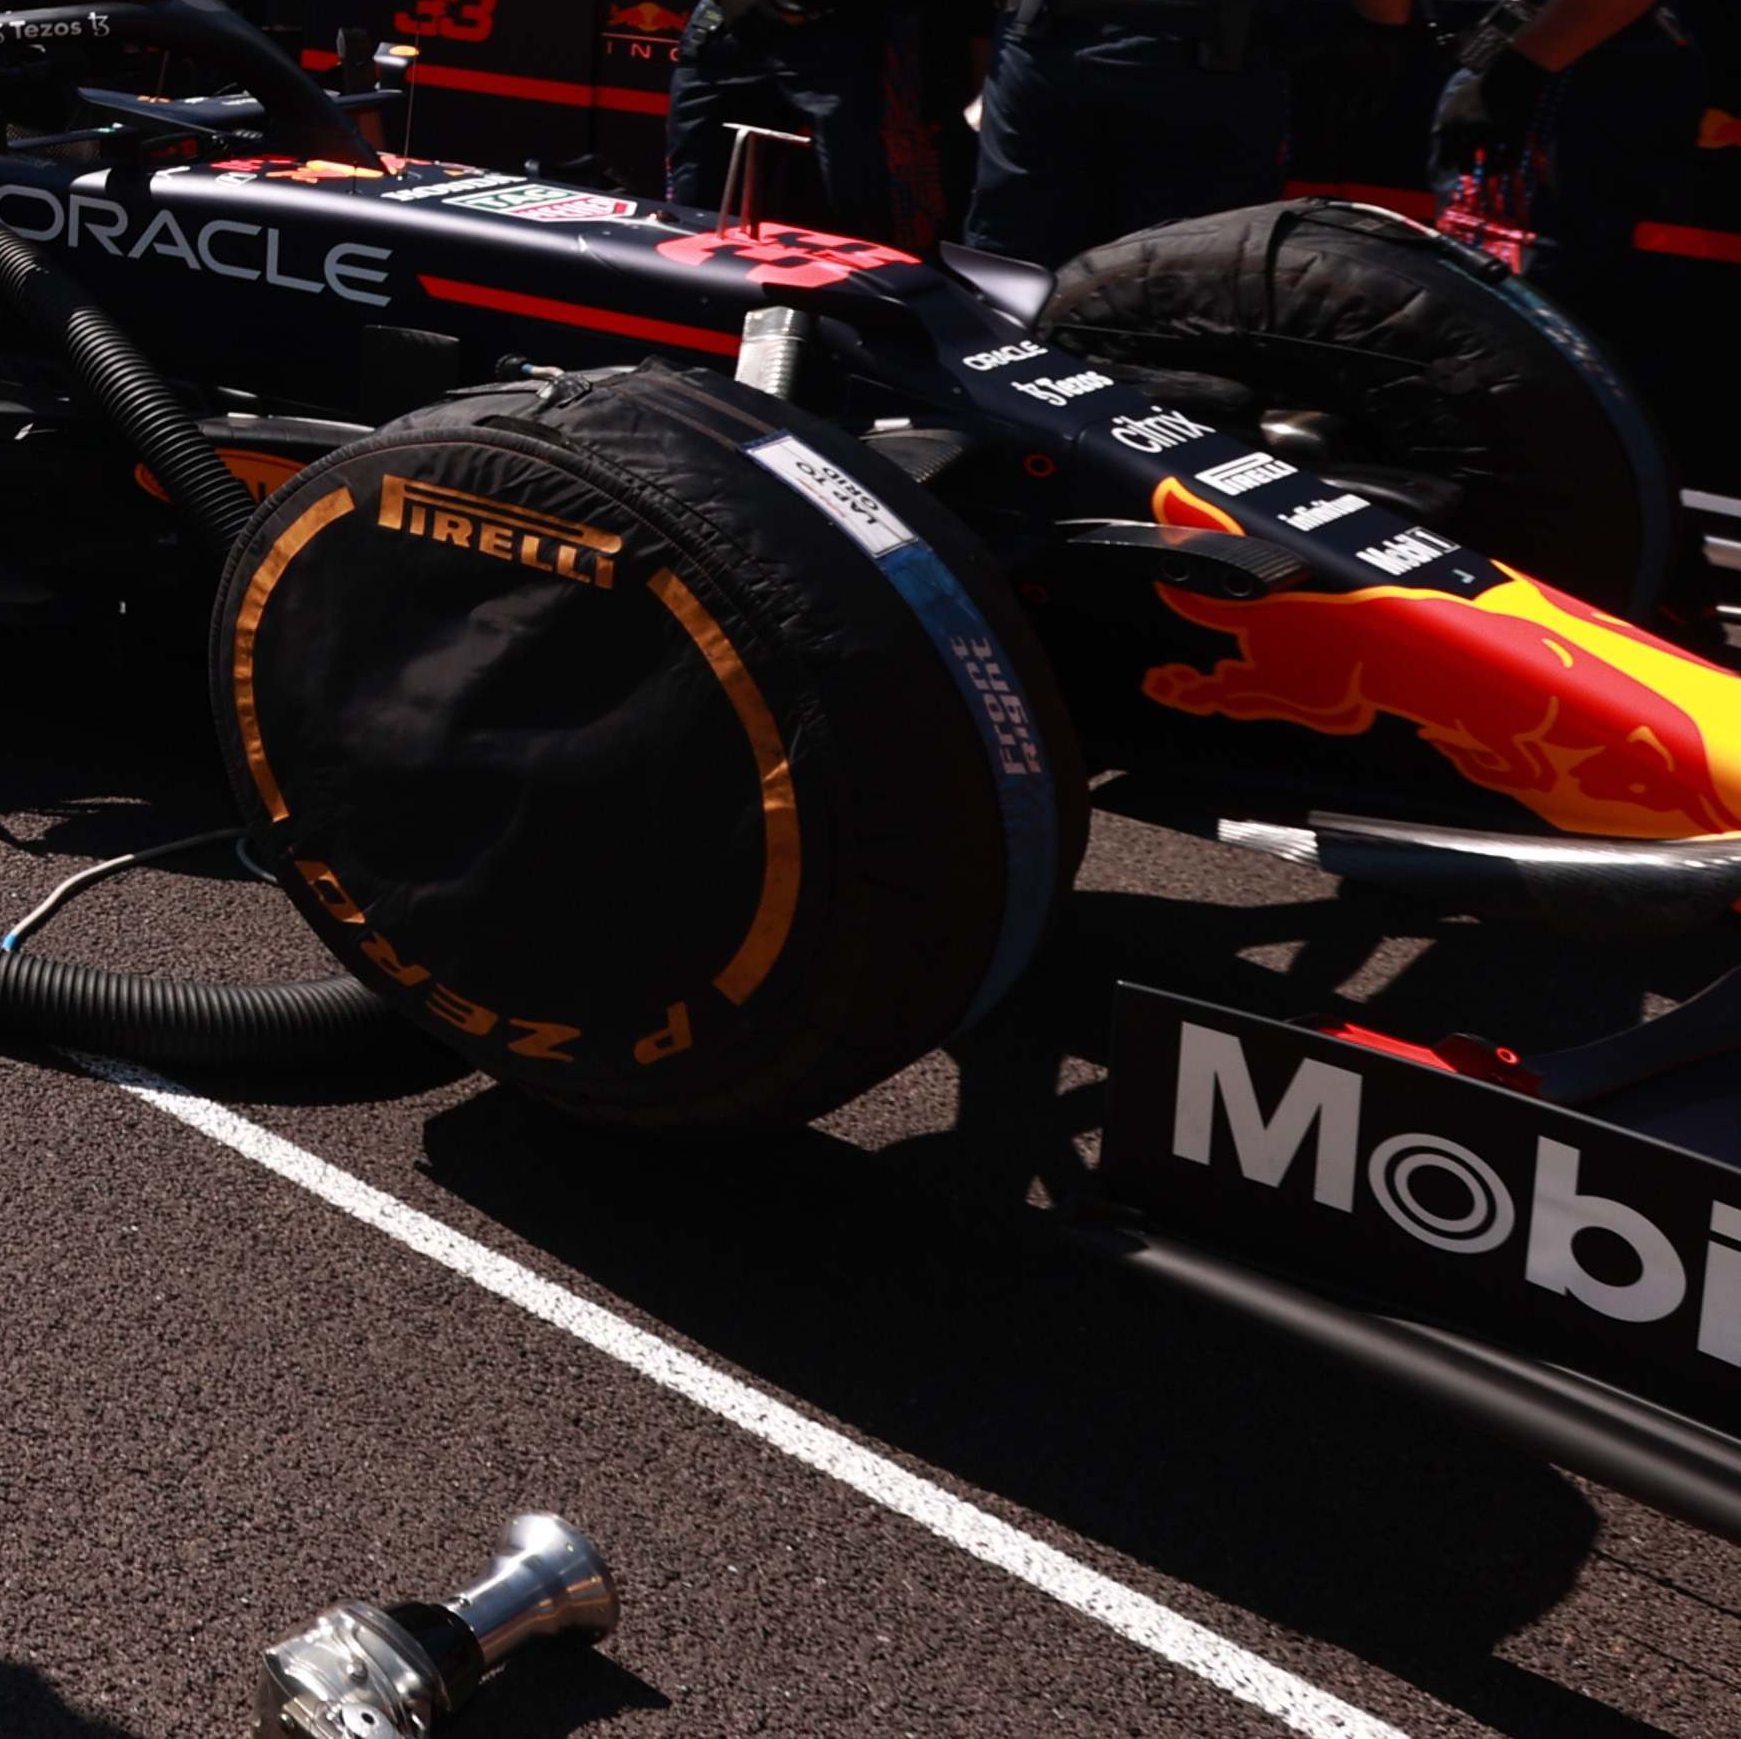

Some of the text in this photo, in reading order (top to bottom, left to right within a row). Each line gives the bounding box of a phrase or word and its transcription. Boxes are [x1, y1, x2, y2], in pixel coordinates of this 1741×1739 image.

[9, 21, 82, 40] Tezos
[381, 176, 528, 202] HONDA
[471, 188, 568, 210] TAG
[963, 340, 1049, 371] ORACLE
[1035, 370, 1115, 399] Tezos
[1110, 405, 1217, 454] citrix
[796, 461, 828, 487] TO
[823, 467, 880, 512] GRID
[1194, 452, 1299, 496] PIRELLI
[832, 490, 878, 526] LAP
[1277, 494, 1371, 531] infinitum
[378, 474, 623, 589] PIRELLI
[1355, 531, 1443, 576] Mobil
[950, 636, 1029, 775] Front
[970, 637, 1043, 774] Right
[292, 859, 694, 1066] P ZERO
